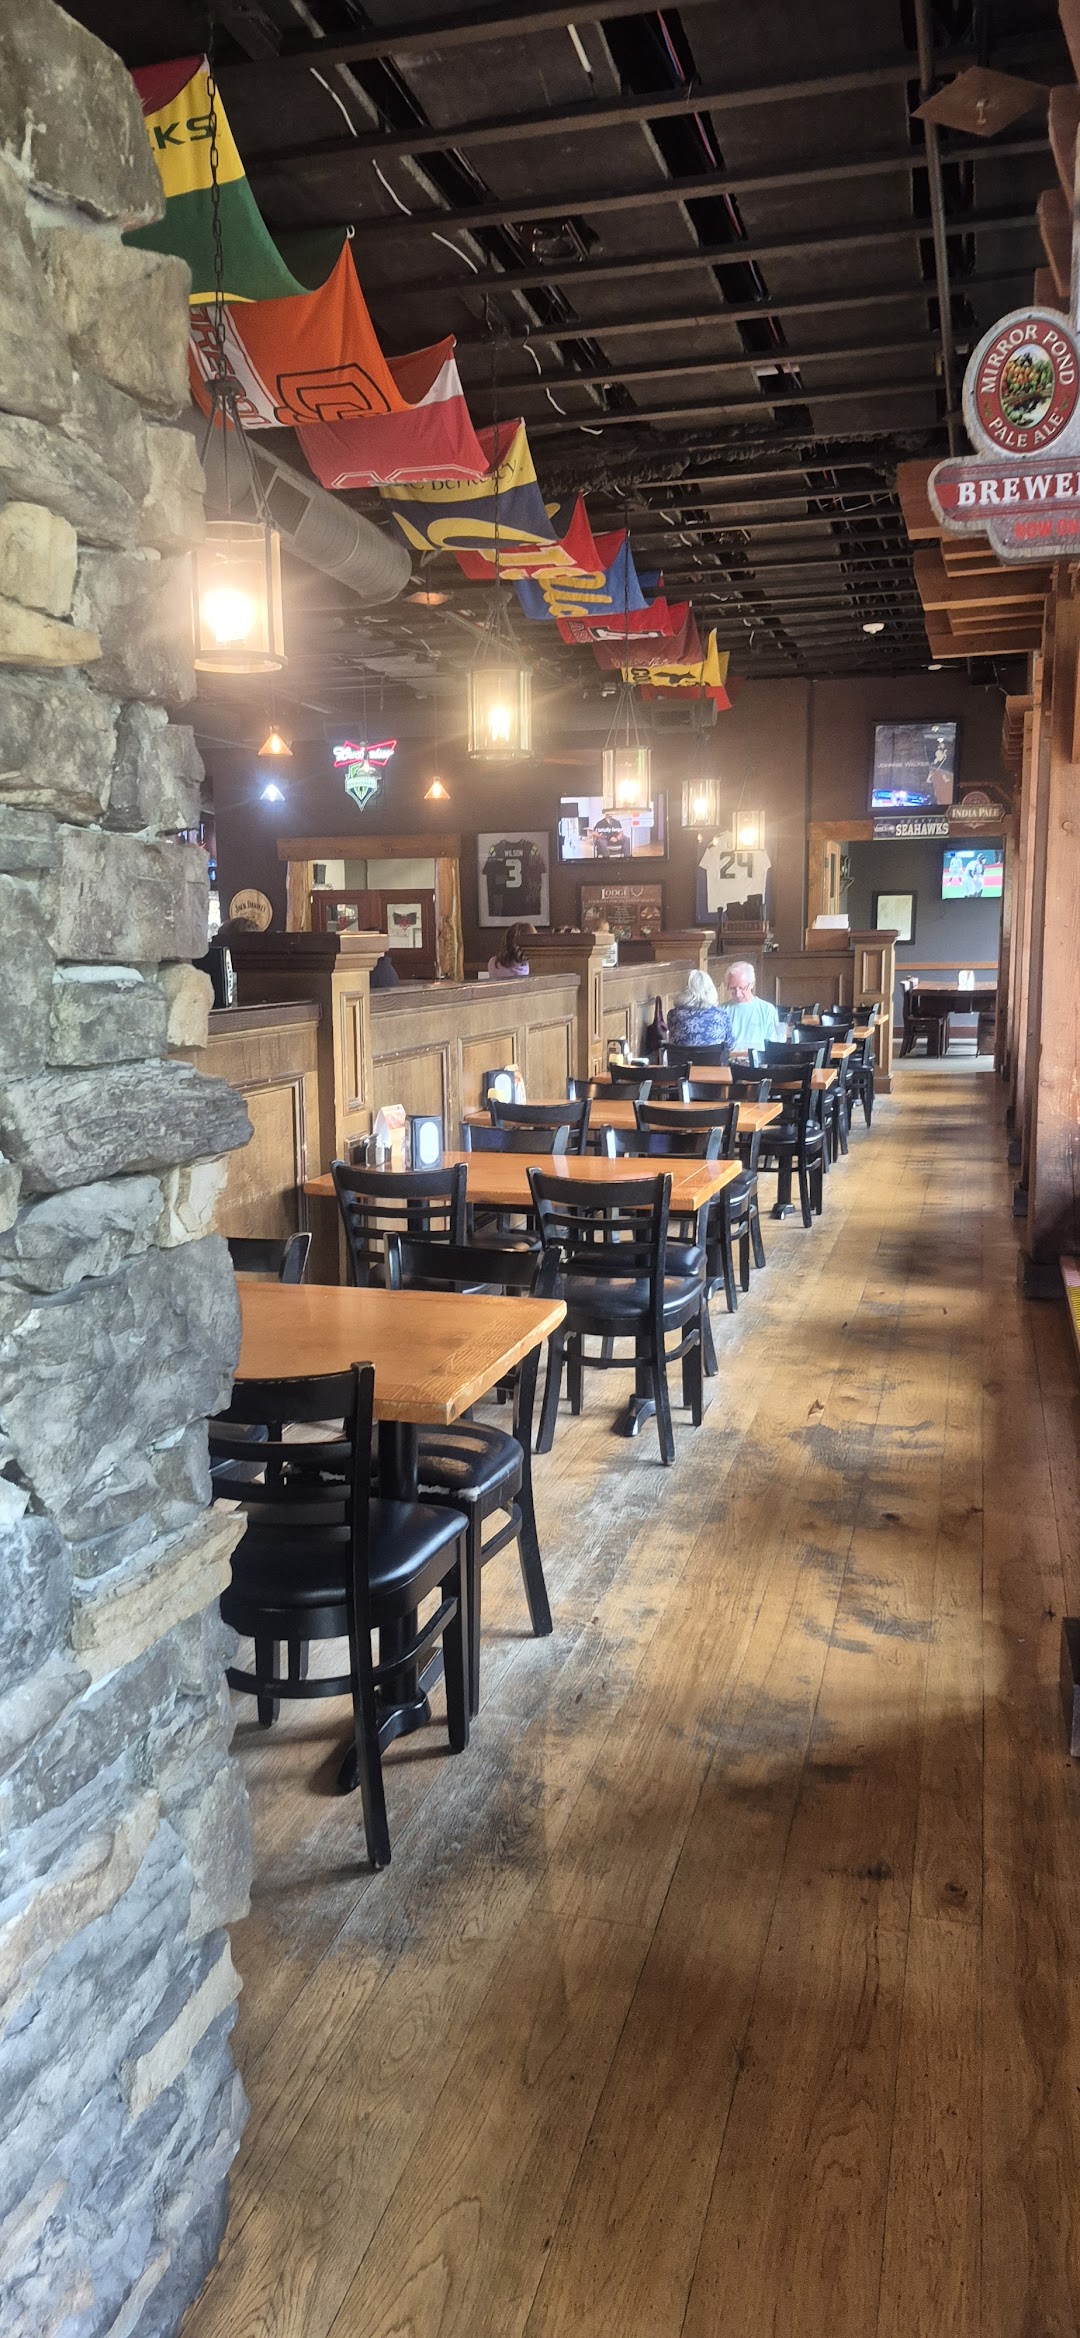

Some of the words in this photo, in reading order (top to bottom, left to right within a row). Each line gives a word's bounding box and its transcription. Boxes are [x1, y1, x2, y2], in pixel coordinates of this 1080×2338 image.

[980, 324, 1038, 394] MIRROR
[1042, 329, 1075, 386] POND
[988, 416, 1028, 448] PALE
[1033, 411, 1064, 445] ALE
[957, 471, 1080, 507] BREWE
[1014, 521, 1052, 540] NOW
[951, 808, 977, 818] INDIA
[978, 808, 999, 817] PALE
[895, 822, 949, 836] SEAHAWKS
[504, 849, 524, 857] WILSON
[719, 850, 753, 879] 24
[505, 858, 522, 888] 3
